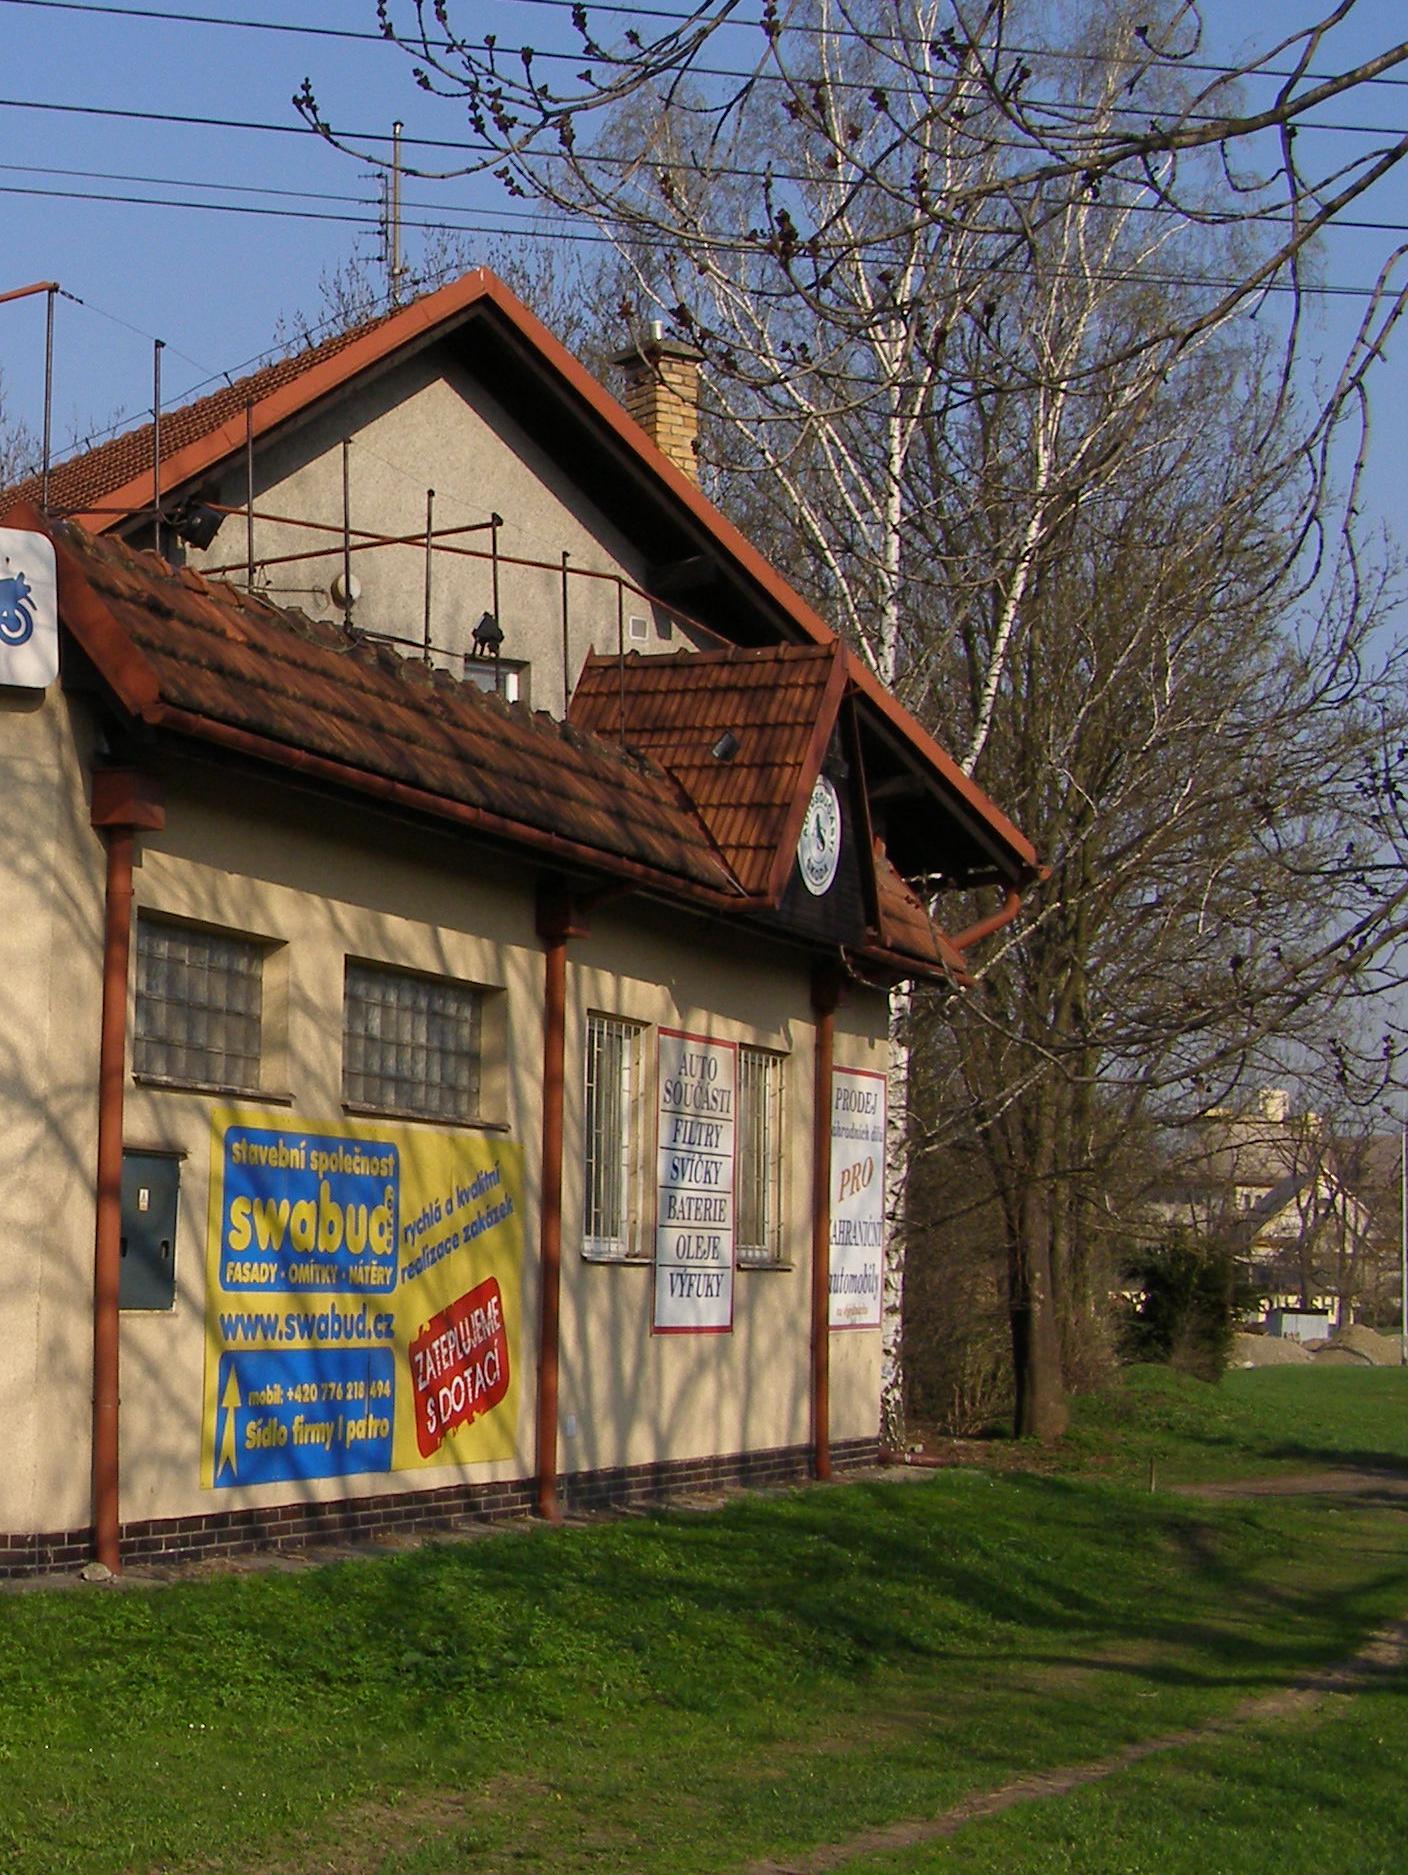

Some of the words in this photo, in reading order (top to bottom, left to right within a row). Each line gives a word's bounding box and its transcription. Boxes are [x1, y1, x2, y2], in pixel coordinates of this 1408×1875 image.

[678, 1051, 718, 1081] AUTO
[663, 1076, 731, 1115] SOUČÁSTI
[835, 1087, 878, 1116] PRODEJ
[672, 1118, 724, 1149] FILTRY
[232, 1137, 307, 1170] stavební
[310, 1146, 395, 1180] společnost
[670, 1153, 723, 1186] SVÍČKY
[838, 1155, 874, 1203] PRO
[228, 1179, 394, 1255] swabud
[403, 1198, 442, 1248] rychlá
[445, 1197, 453, 1217] a
[668, 1195, 727, 1224] BATERIE
[400, 1232, 460, 1285] realizace
[462, 1191, 514, 1244] zakázek
[676, 1234, 720, 1261] OLEJE
[830, 1214, 883, 1248] AHRANIČNÍ
[288, 1259, 339, 1284] OMÍTKY
[348, 1258, 393, 1286] NÁTĚRY
[669, 1266, 724, 1299] VÝFUKY
[219, 1302, 395, 1341] www.swabud.cz
[414, 1295, 502, 1391] ZATEPLUJEME
[248, 1383, 284, 1406] mobil:
[286, 1383, 318, 1403] +420
[426, 1396, 437, 1433] S
[438, 1338, 501, 1424] DOTACÍ
[245, 1417, 288, 1450] Sídlo
[293, 1414, 334, 1451] firmy
[346, 1413, 390, 1449] patro
